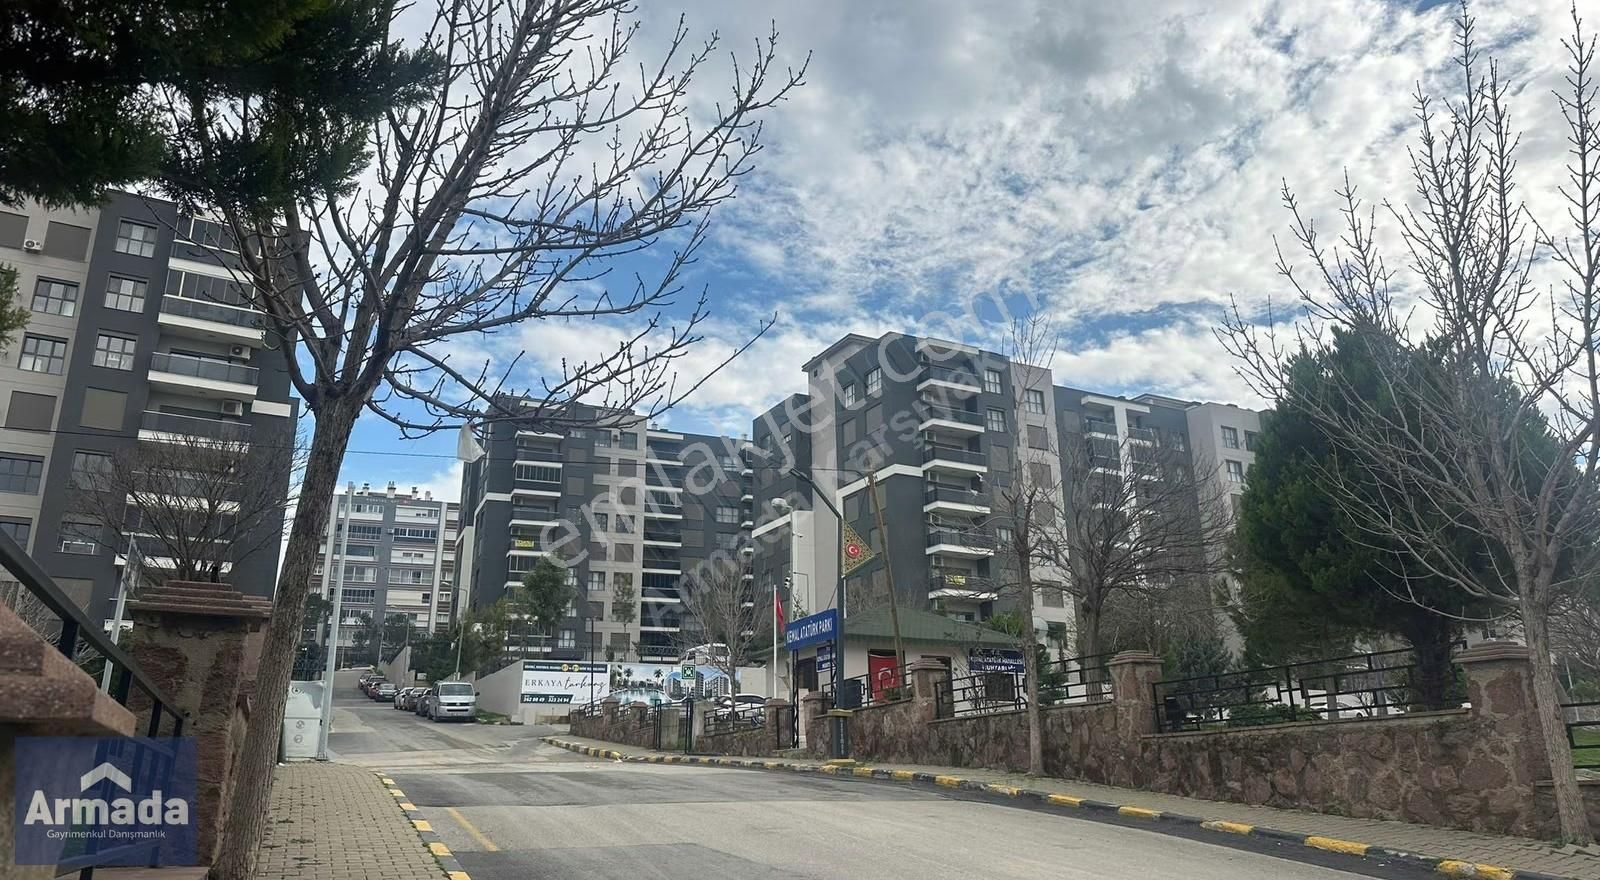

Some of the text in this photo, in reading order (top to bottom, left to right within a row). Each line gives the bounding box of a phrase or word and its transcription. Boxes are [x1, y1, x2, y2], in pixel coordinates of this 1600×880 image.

[786, 618, 832, 643] KEMAL ATATÜRK PARKI
